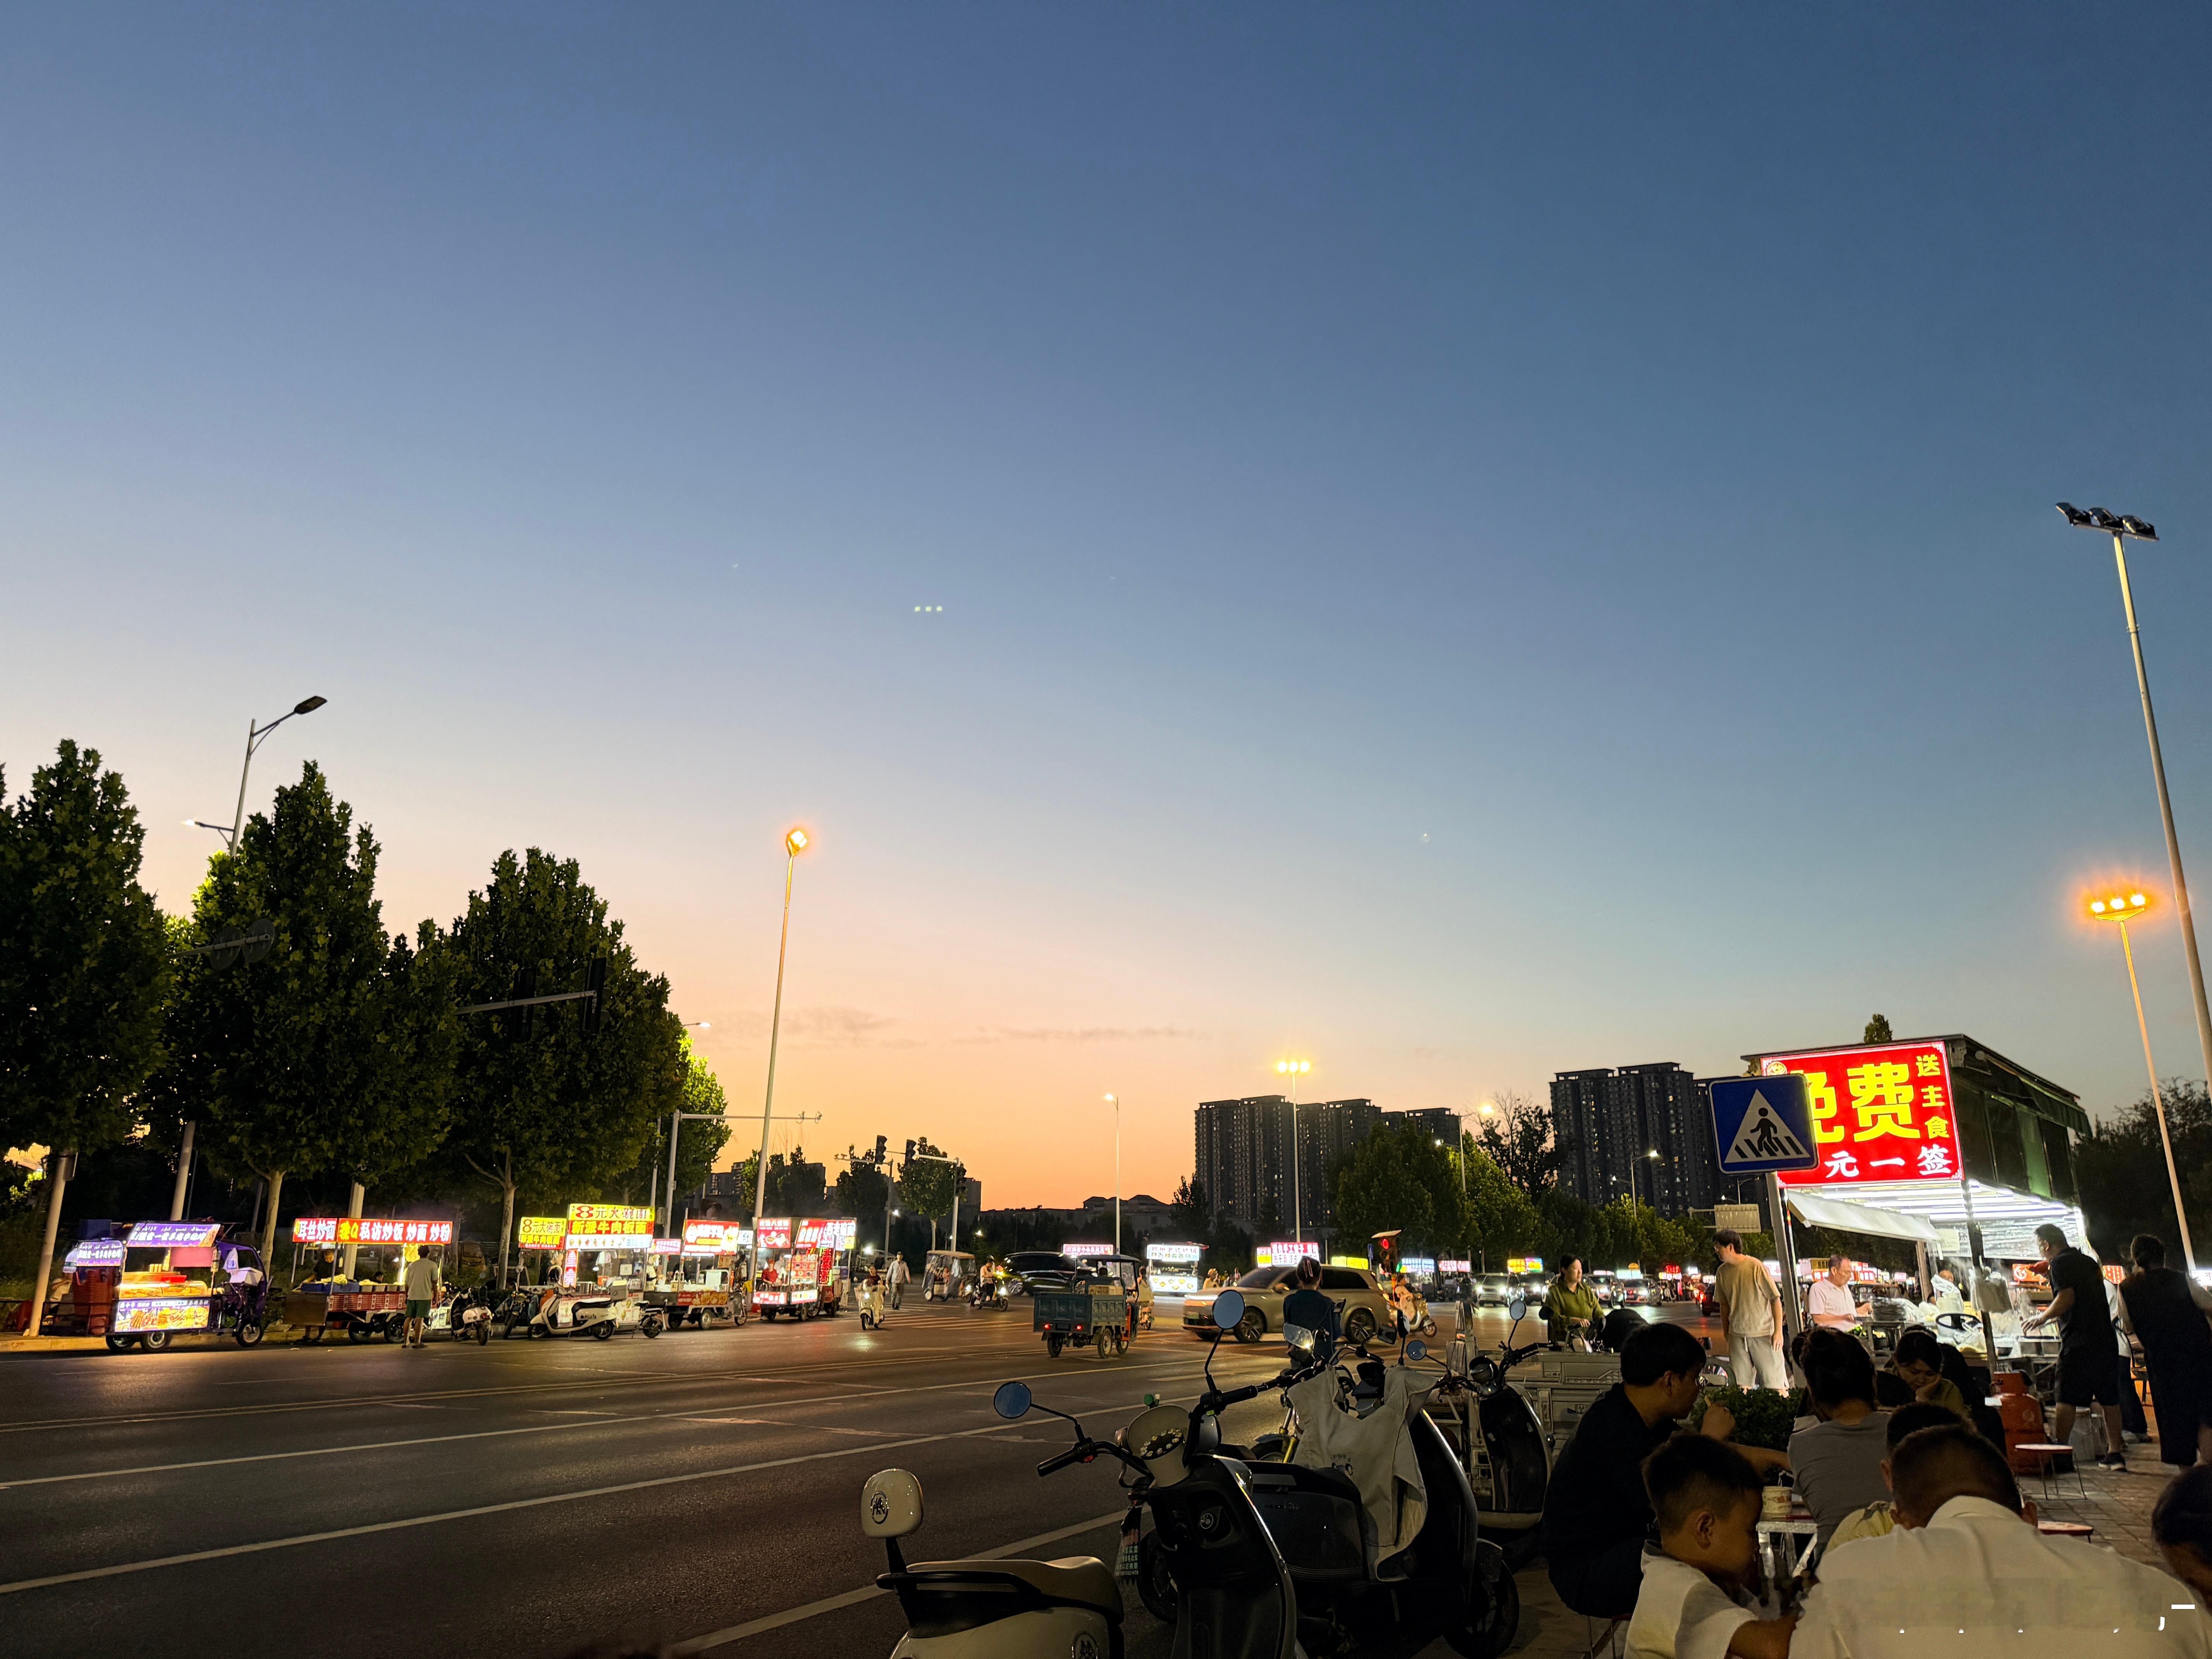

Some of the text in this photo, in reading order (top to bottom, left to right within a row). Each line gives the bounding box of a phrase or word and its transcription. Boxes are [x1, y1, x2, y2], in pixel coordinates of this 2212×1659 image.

[1915, 1054, 1949, 1139] 送主食
[1824, 1144, 1953, 1179] 元一签
[572, 1220, 647, 1234] 新派牛肉板面
